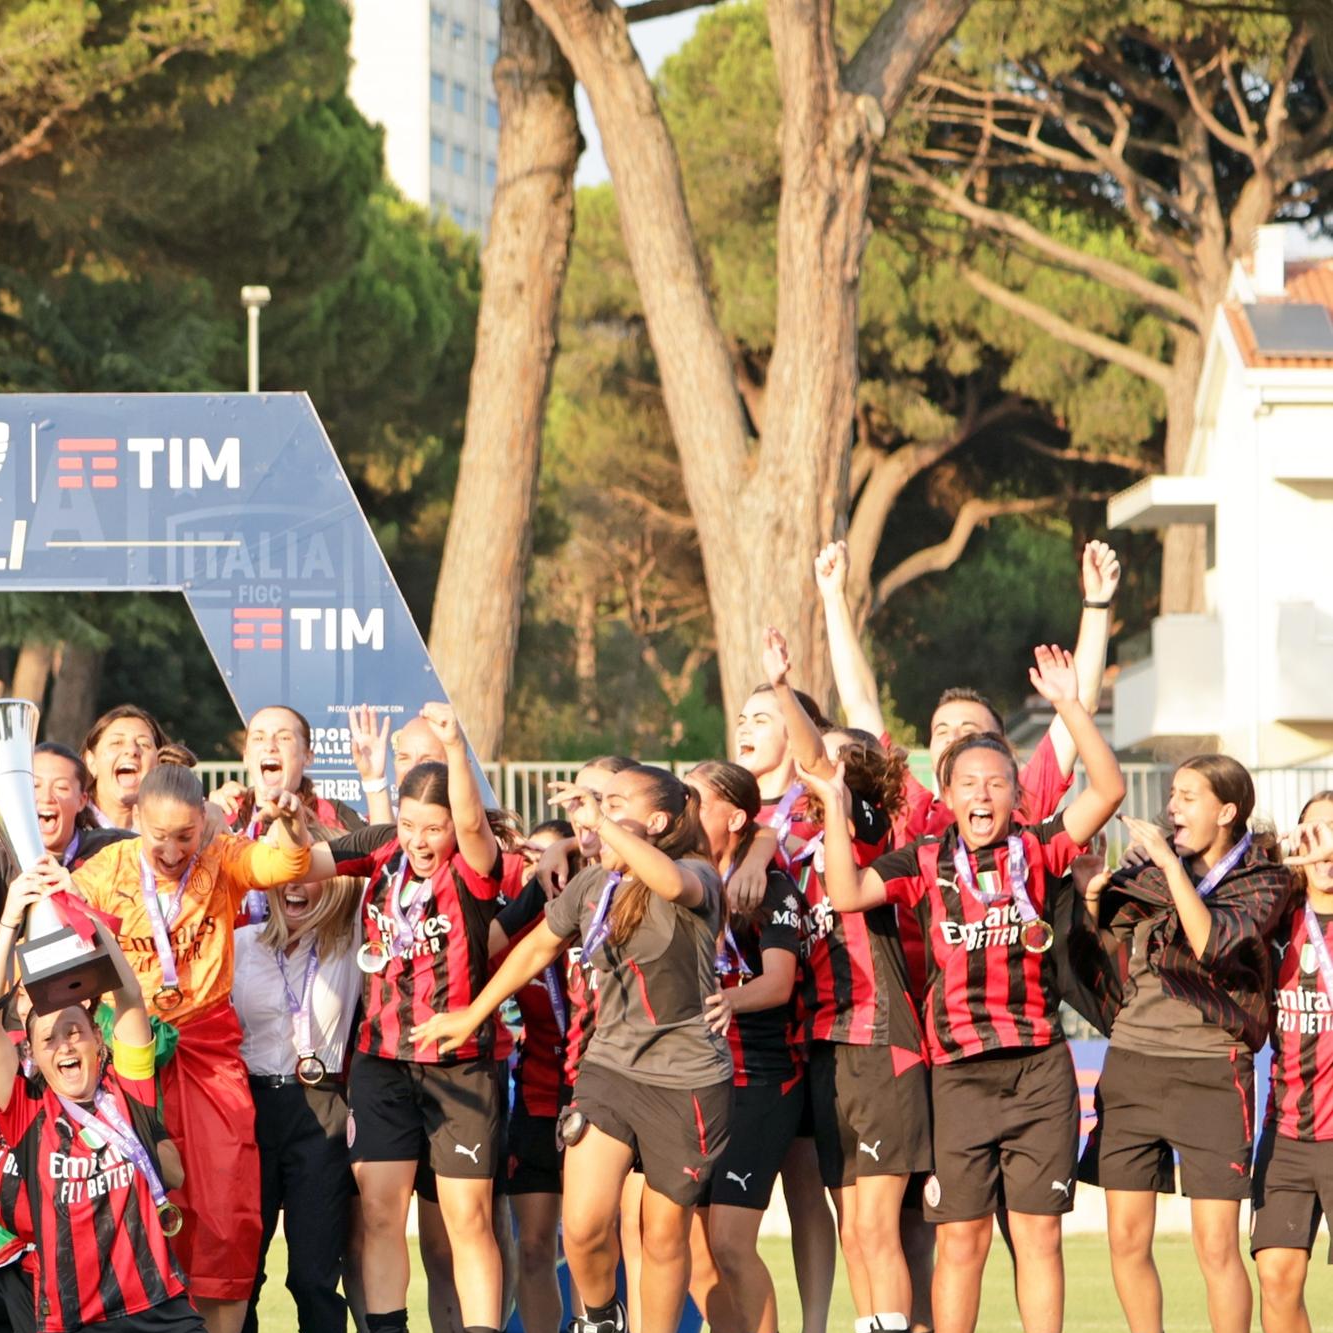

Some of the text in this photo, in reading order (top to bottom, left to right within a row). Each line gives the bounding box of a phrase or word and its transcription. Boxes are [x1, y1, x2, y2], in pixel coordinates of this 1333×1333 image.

[127, 437, 241, 489] TIM
[183, 531, 336, 579] ITALIA
[238, 584, 283, 604] FIGC
[290, 607, 384, 650] TIM
[310, 728, 351, 741] POR
[310, 742, 351, 754] ALLE
[61, 1181, 83, 1204] FLY
